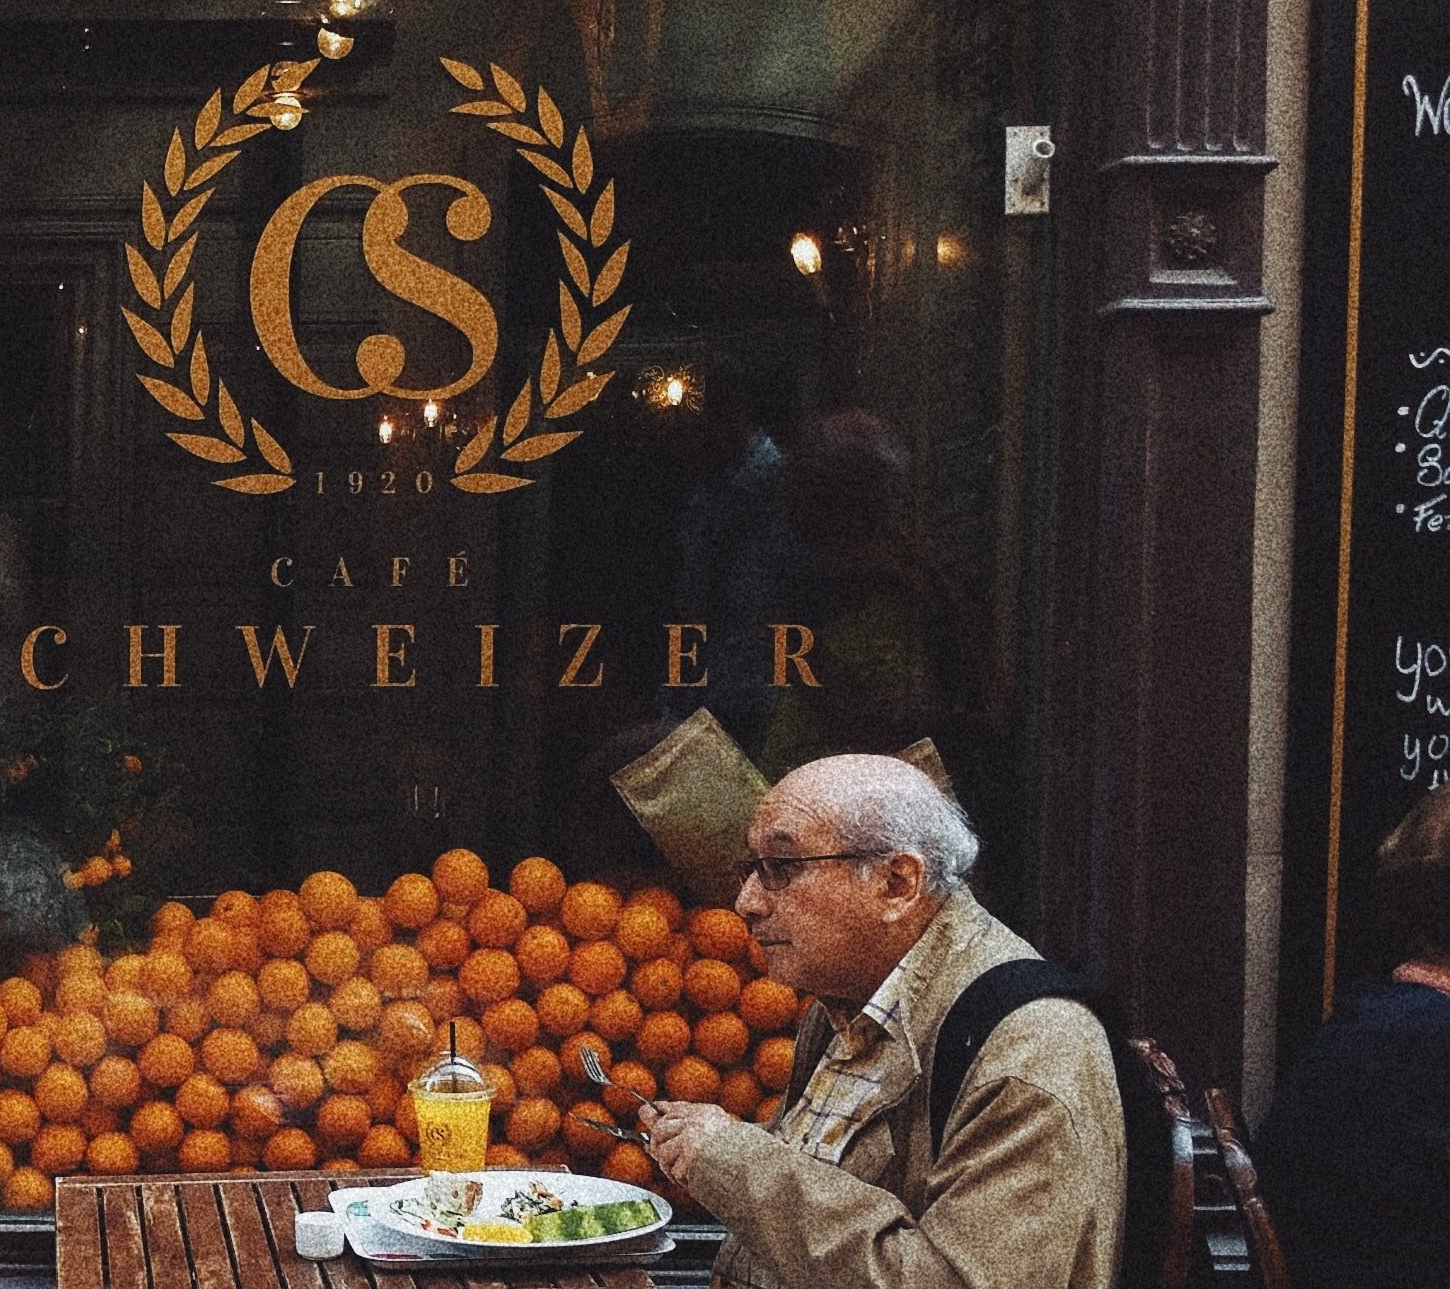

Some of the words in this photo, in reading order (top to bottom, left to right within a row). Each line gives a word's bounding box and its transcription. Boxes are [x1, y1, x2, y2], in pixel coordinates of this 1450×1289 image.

[314, 471, 435, 494] 1920
[270, 550, 471, 589] CAFÉ
[1396, 635, 1450, 703] yo
